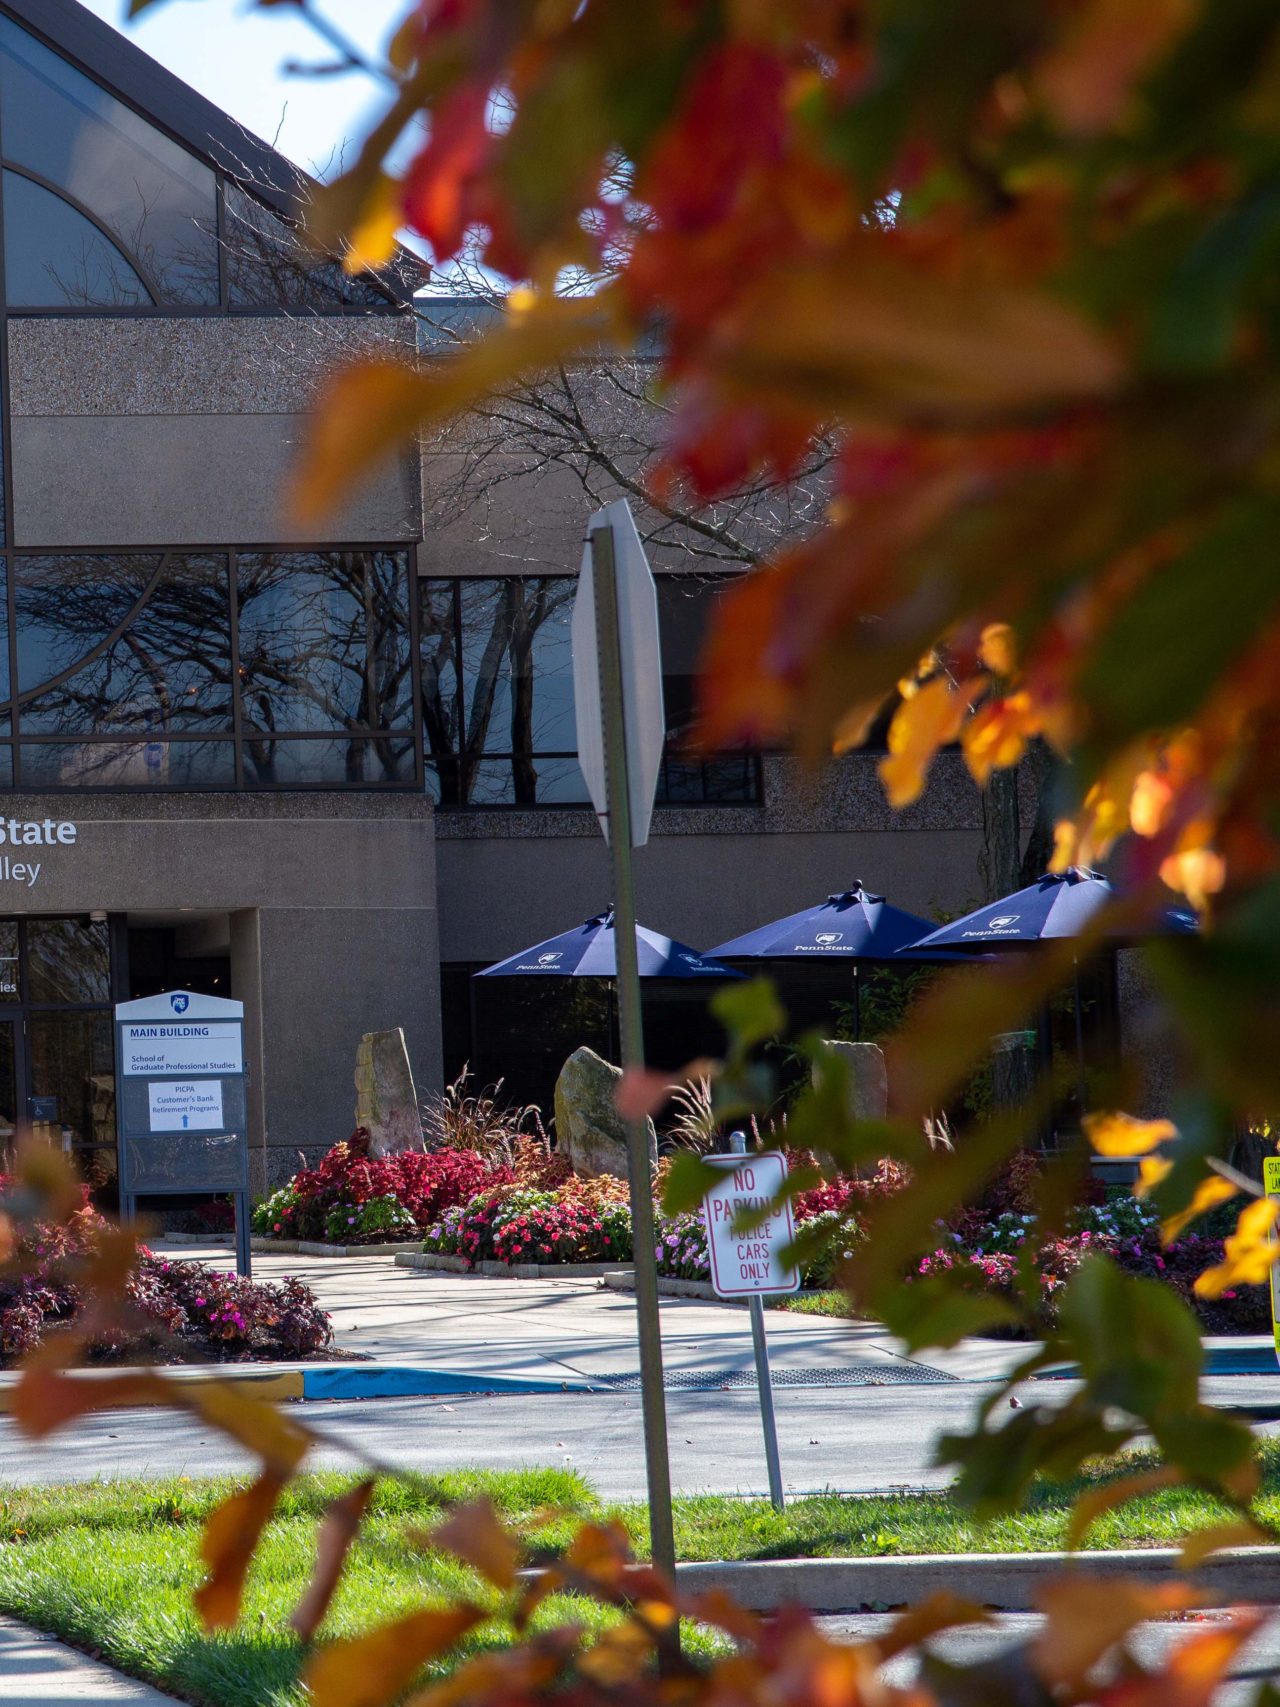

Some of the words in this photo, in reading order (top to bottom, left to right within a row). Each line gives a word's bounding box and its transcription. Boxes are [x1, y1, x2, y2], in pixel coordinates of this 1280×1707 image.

[961, 929, 1020, 937] PennState
[130, 1028, 157, 1037] MAIN
[160, 1027, 209, 1037] BUILDING
[131, 1063, 164, 1071] Graduate
[166, 1062, 208, 1071] Professional
[210, 1061, 236, 1069] Studies
[157, 1096, 195, 1104] Customer's
[189, 1104, 220, 1112] Programs
[734, 1168, 755, 1192] NO
[737, 1243, 770, 1261] CARS
[740, 1262, 770, 1280] ONLY
